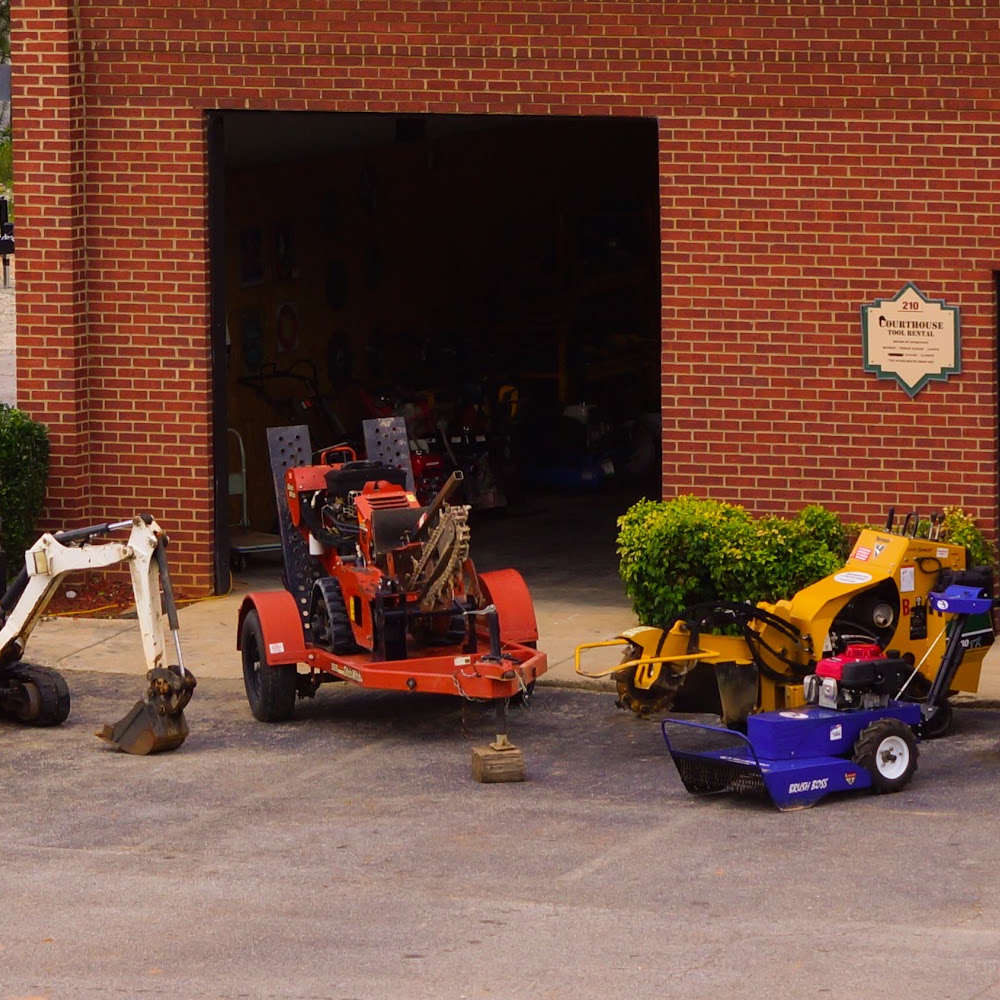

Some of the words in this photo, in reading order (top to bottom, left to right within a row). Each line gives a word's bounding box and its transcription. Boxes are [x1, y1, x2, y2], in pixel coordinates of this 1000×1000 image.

[902, 301, 919, 310] 210
[879, 315, 944, 330] COURTHOUSE
[788, 781, 811, 794] BRUSH
[811, 777, 829, 791] BOSS
